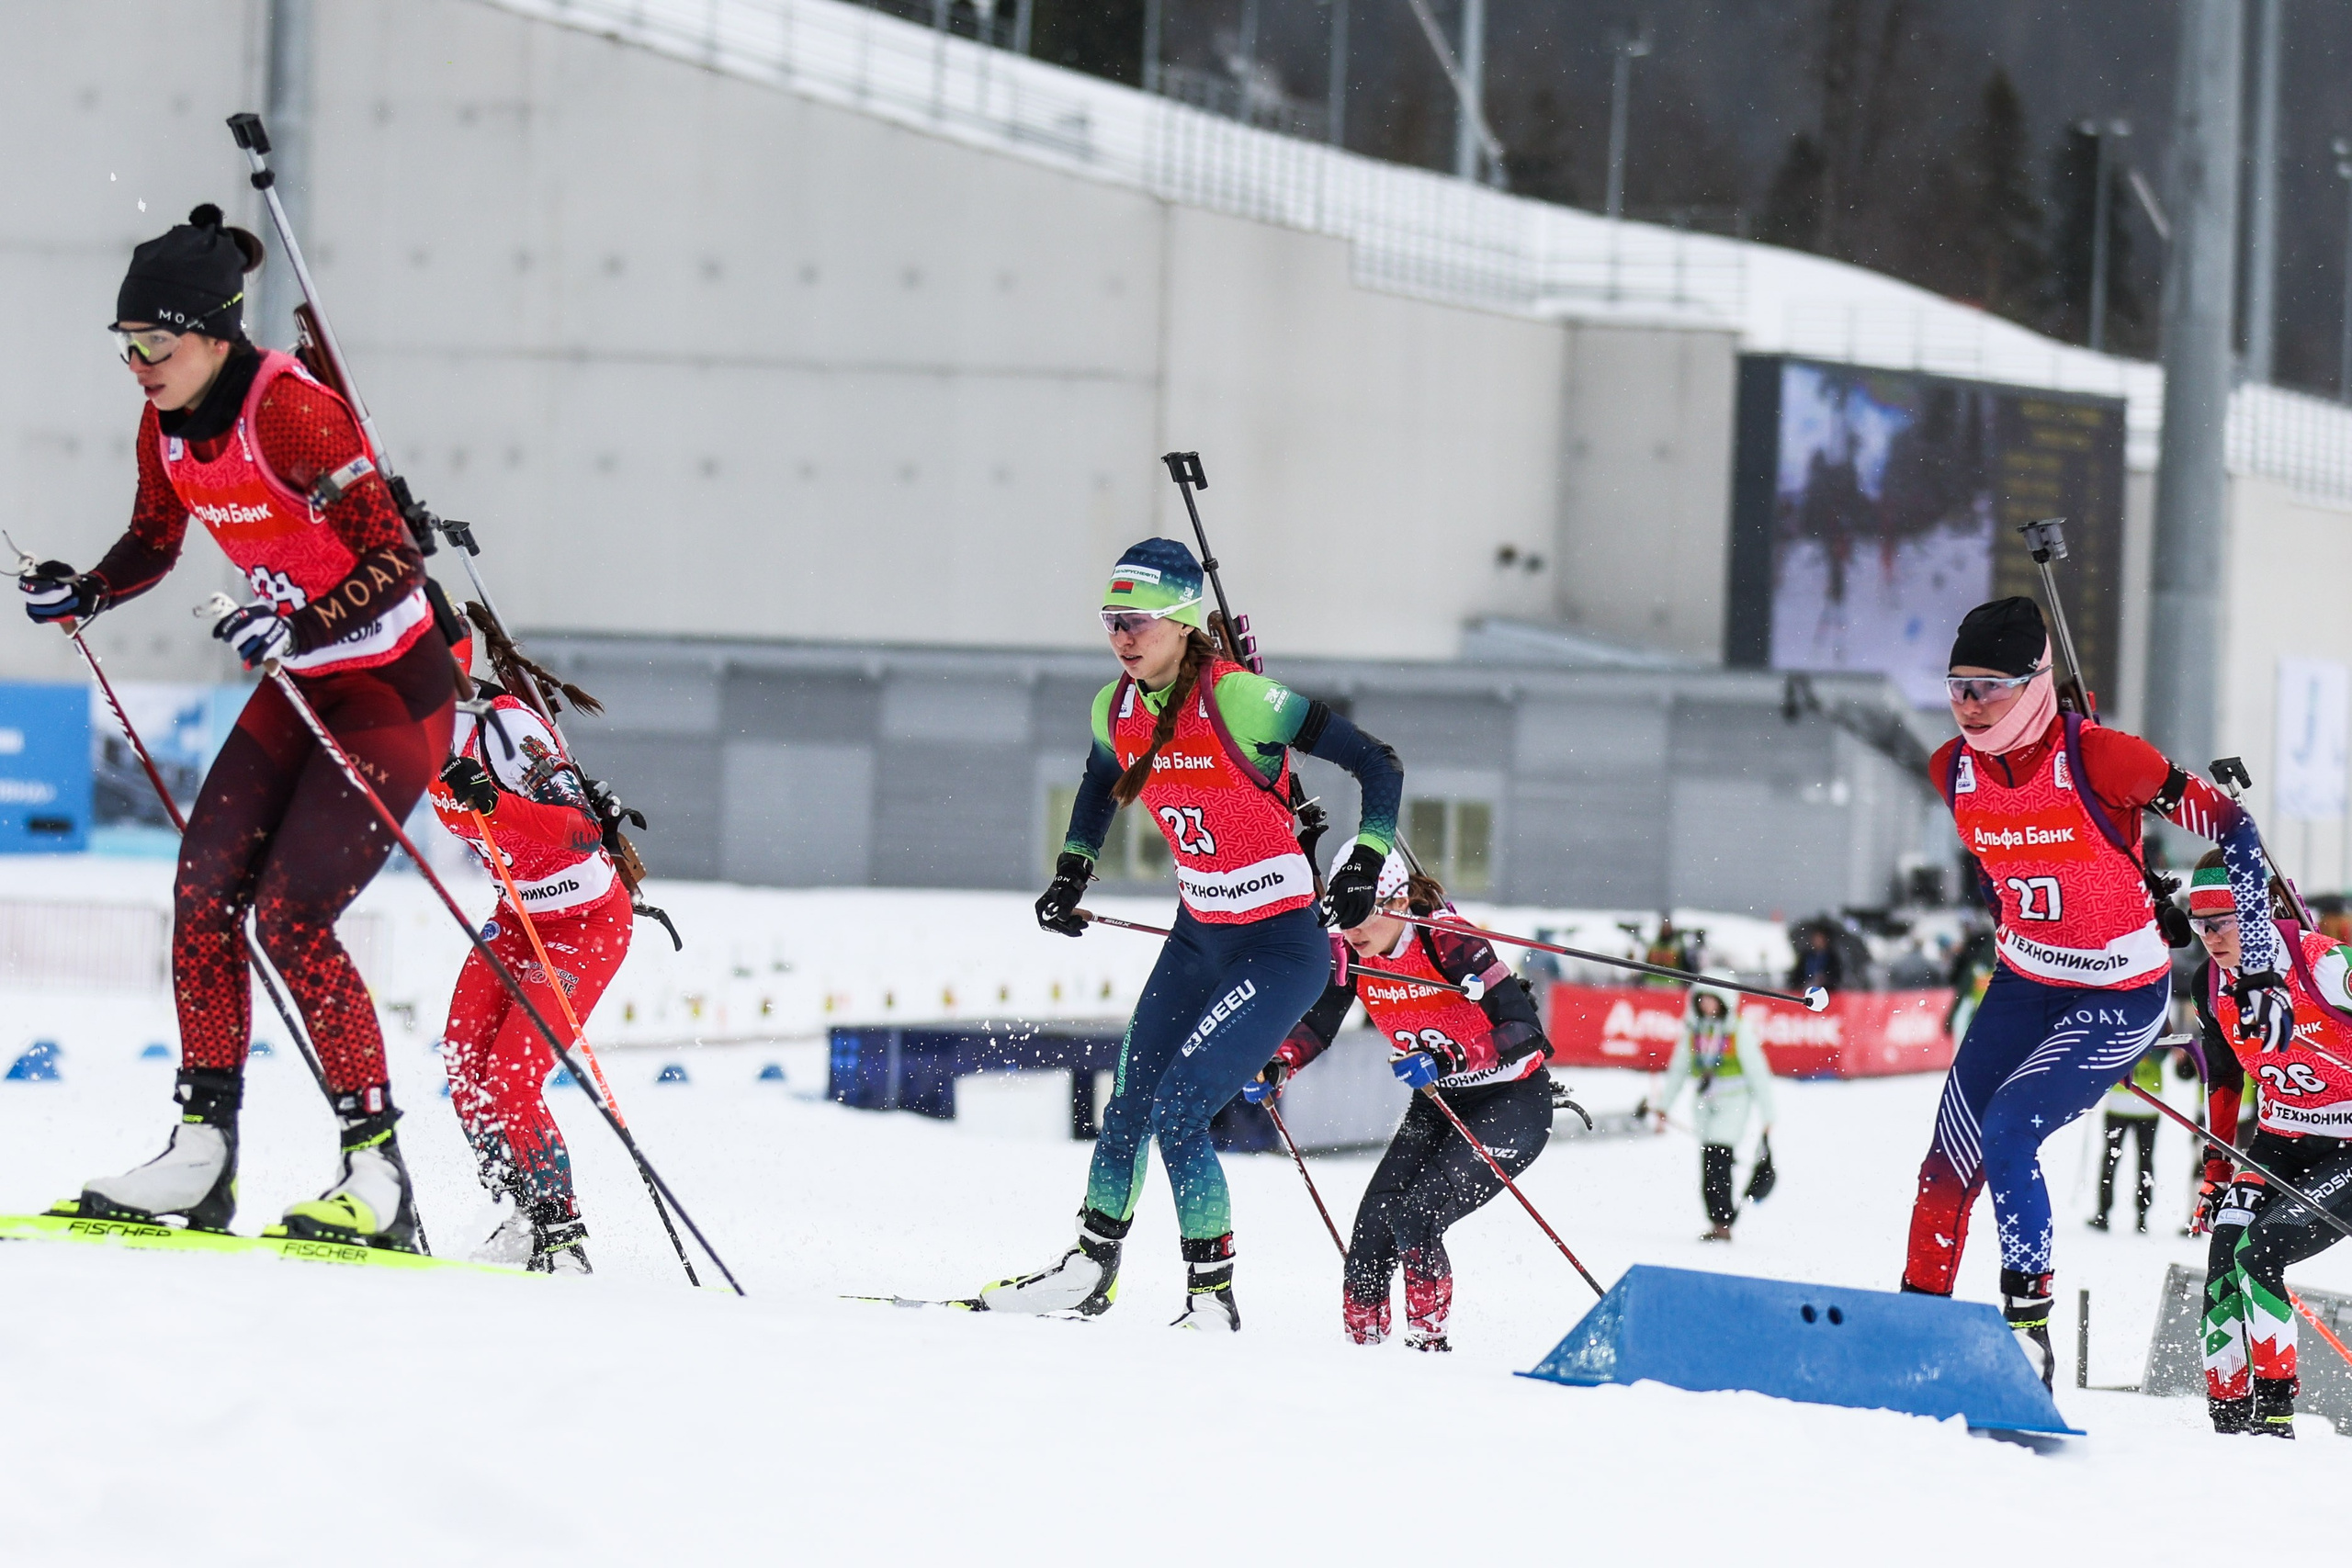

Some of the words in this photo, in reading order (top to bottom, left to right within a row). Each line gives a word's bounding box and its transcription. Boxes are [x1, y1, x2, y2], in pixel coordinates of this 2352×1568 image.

[228, 502, 274, 524] Банк
[313, 549, 411, 629] MOAX
[346, 752, 390, 784] OAX
[1127, 751, 1171, 773] Афа
[1172, 751, 1215, 770] Банк
[1159, 806, 1216, 856] 23
[1975, 827, 2023, 851] Альфа
[2025, 826, 2075, 844] Банк
[1180, 872, 1284, 899] ЕХНОНИКОЛЬ
[2007, 876, 2062, 921] 27
[2011, 932, 2129, 971] ТЕХНОНИКОЛЬ
[1367, 984, 1407, 1004] Альфа
[1409, 983, 1443, 998] Банк
[1198, 978, 1257, 1037] BEEU
[2053, 1009, 2128, 1030] MOAX
[2291, 1021, 2324, 1038] анк
[2258, 1062, 2328, 1096] 26
[2288, 1168, 2352, 1218] NRDSK
[284, 1242, 368, 1261] FISCHER
[1188, 1280, 1230, 1293] FISCHER
